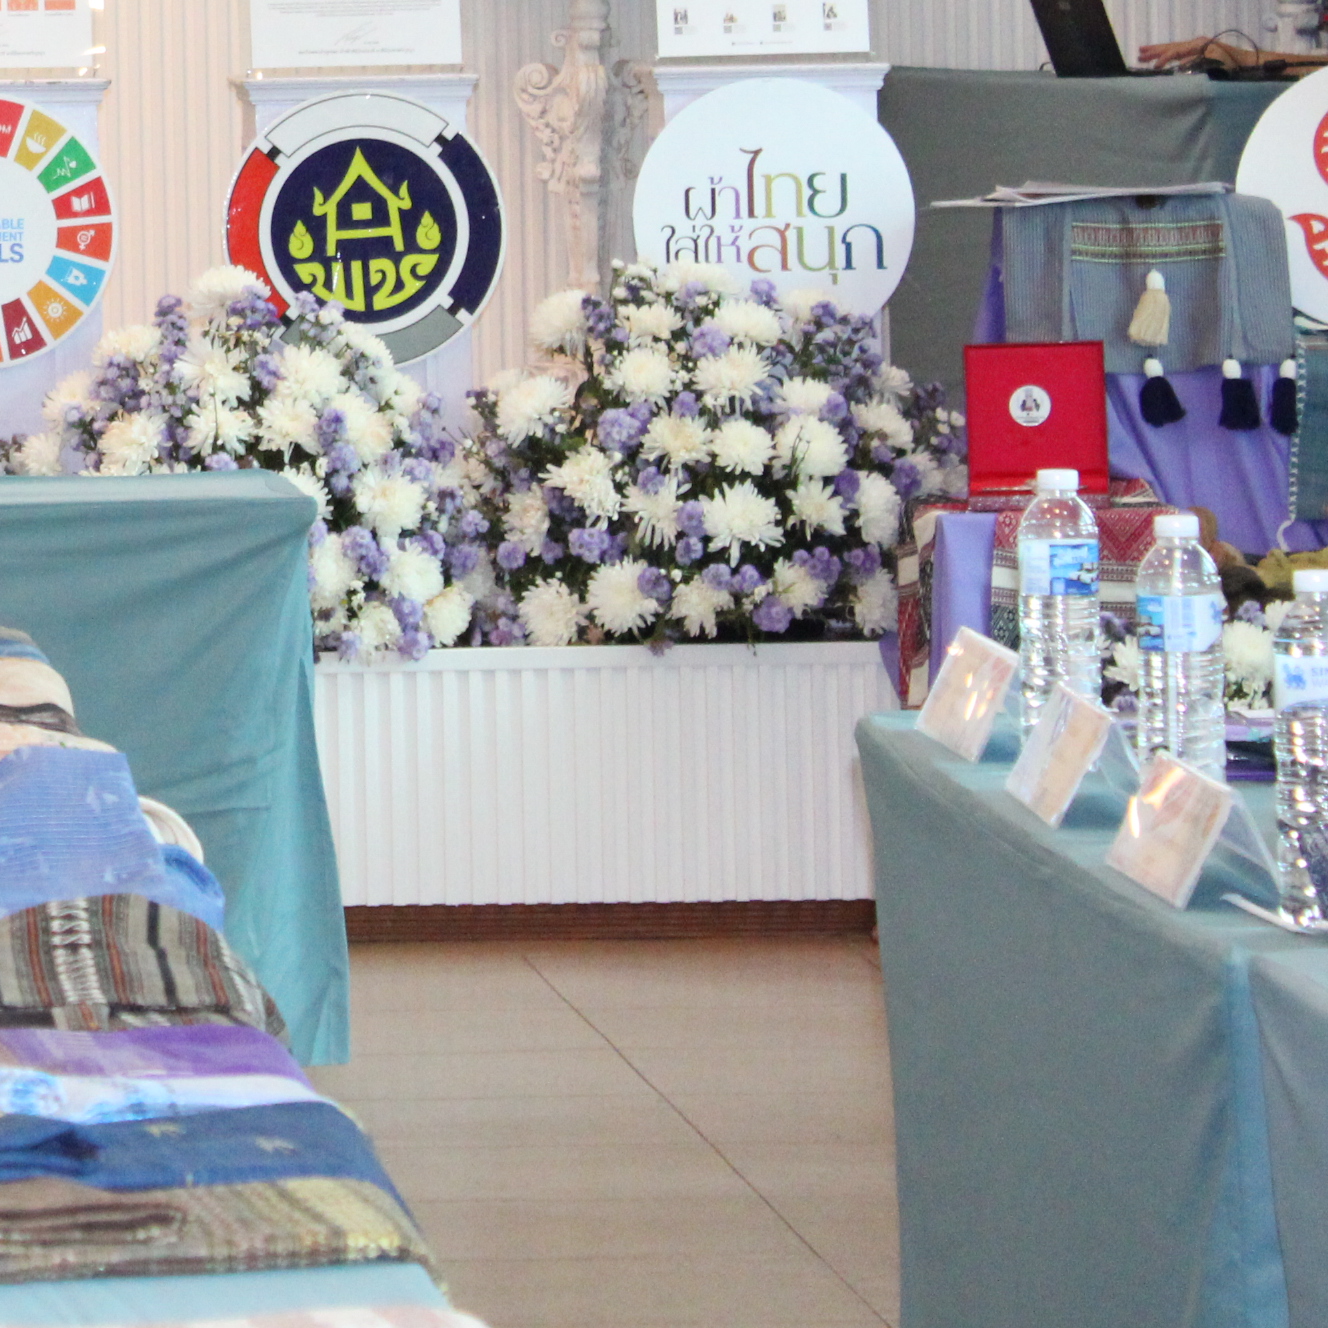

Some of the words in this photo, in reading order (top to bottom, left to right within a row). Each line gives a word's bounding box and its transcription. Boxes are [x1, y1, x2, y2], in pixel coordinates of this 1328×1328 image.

[684, 147, 848, 221] ผ้าไทย
[660, 223, 888, 285] ใส่ให้สนุก
